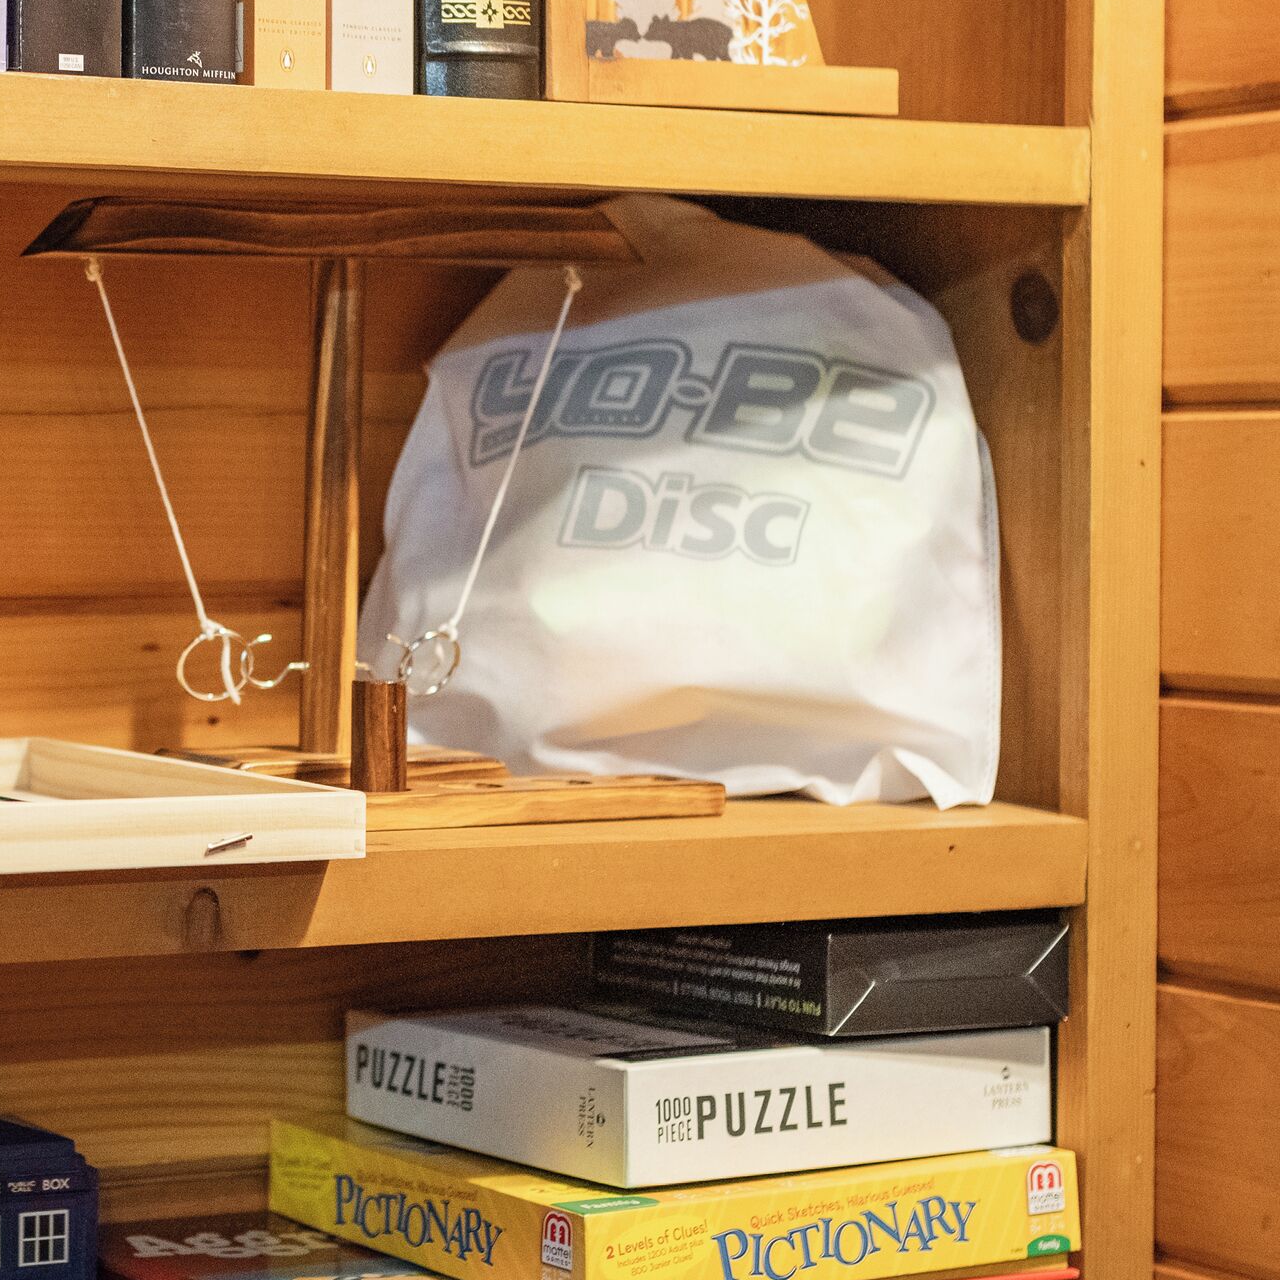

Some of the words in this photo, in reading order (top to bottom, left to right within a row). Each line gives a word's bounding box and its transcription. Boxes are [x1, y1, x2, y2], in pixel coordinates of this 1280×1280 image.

[141, 65, 199, 79] HOUGHTON
[201, 68, 237, 80] MIFFLIN
[356, 1044, 446, 1105] PUZZLE
[656, 1096, 692, 1124] 1000
[695, 1082, 848, 1141] PUZZLE
[657, 1119, 692, 1144] PIECE
[7, 1180, 36, 1188] PUBLIC
[41, 1178, 71, 1191] BOX
[334, 1173, 504, 1267] PICTIONARY
[606, 1244, 615, 1260] 2
[616, 1234, 654, 1257] Levels
[656, 1228, 670, 1246] of
[672, 1218, 709, 1242] Clues!
